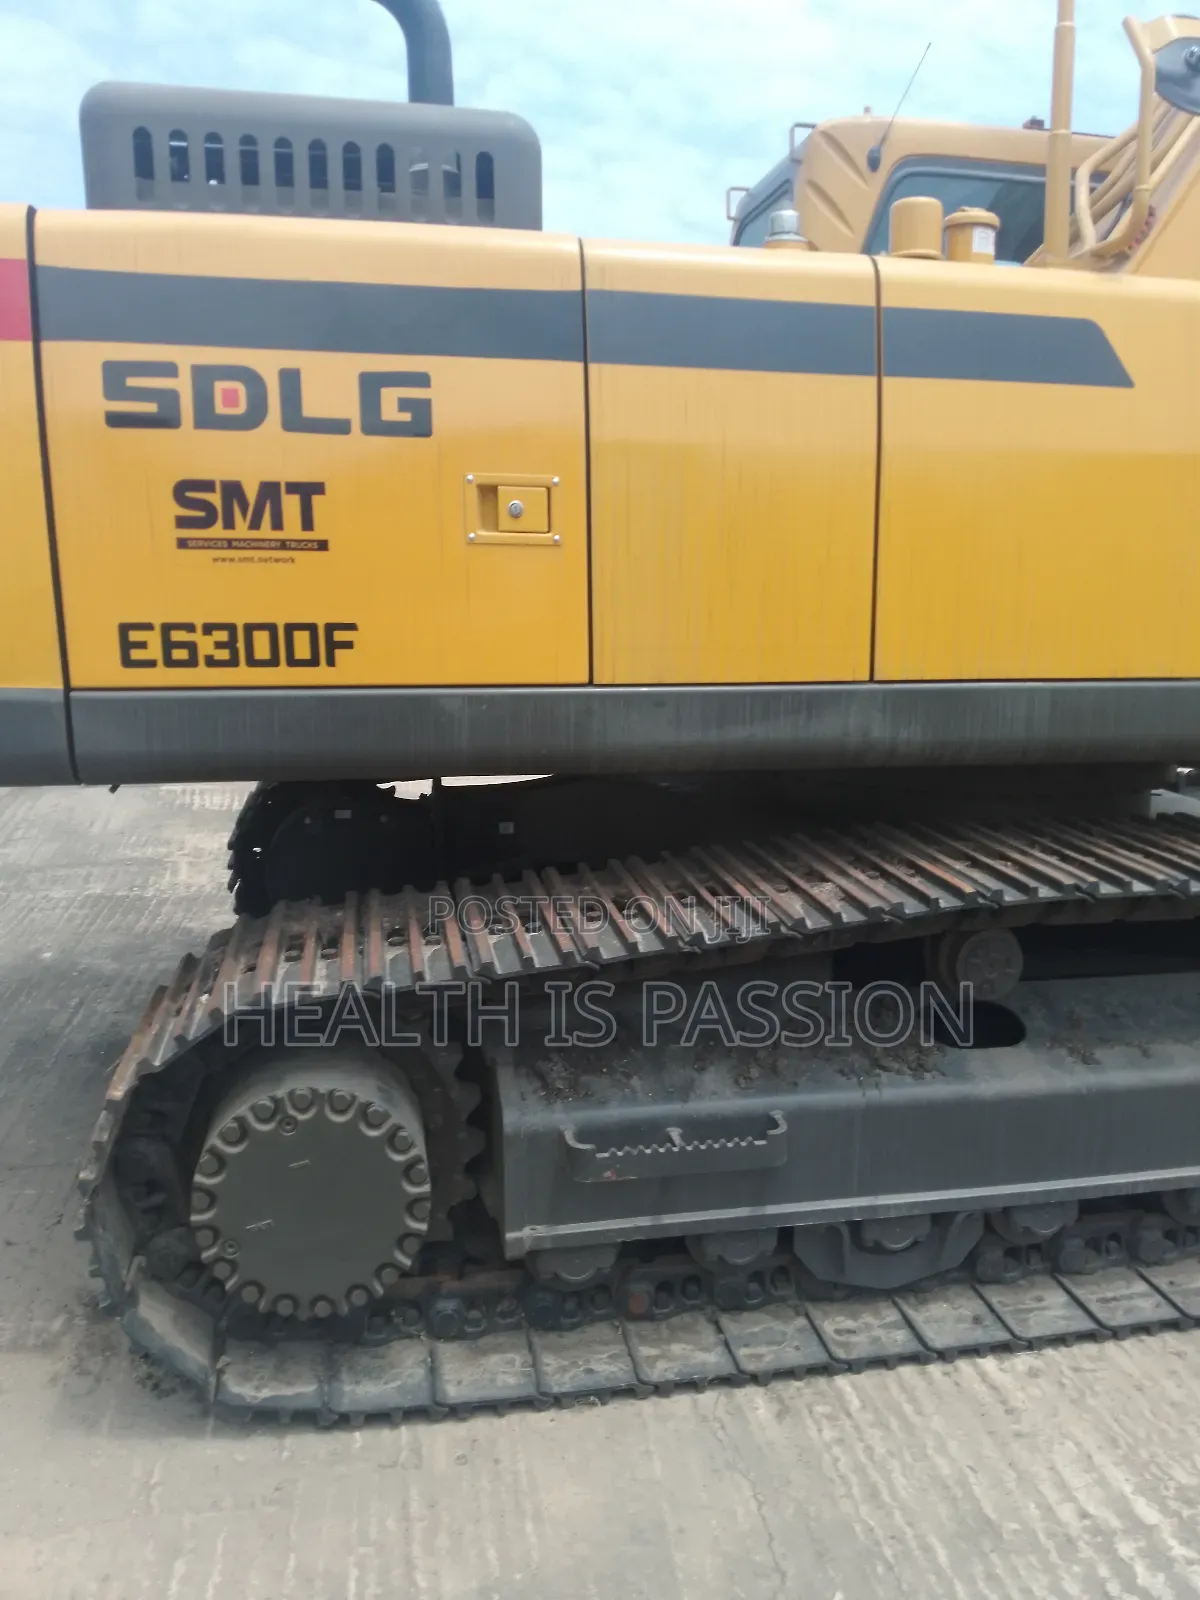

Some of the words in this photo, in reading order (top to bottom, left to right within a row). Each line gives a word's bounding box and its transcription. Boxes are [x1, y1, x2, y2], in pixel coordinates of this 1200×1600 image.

[102, 360, 433, 438] SDLG
[172, 479, 326, 531] SMT
[186, 539, 228, 548] SERVICES
[231, 540, 281, 549] MACHINERY
[285, 541, 318, 549] TRUCKS
[118, 622, 359, 669] E6300F
